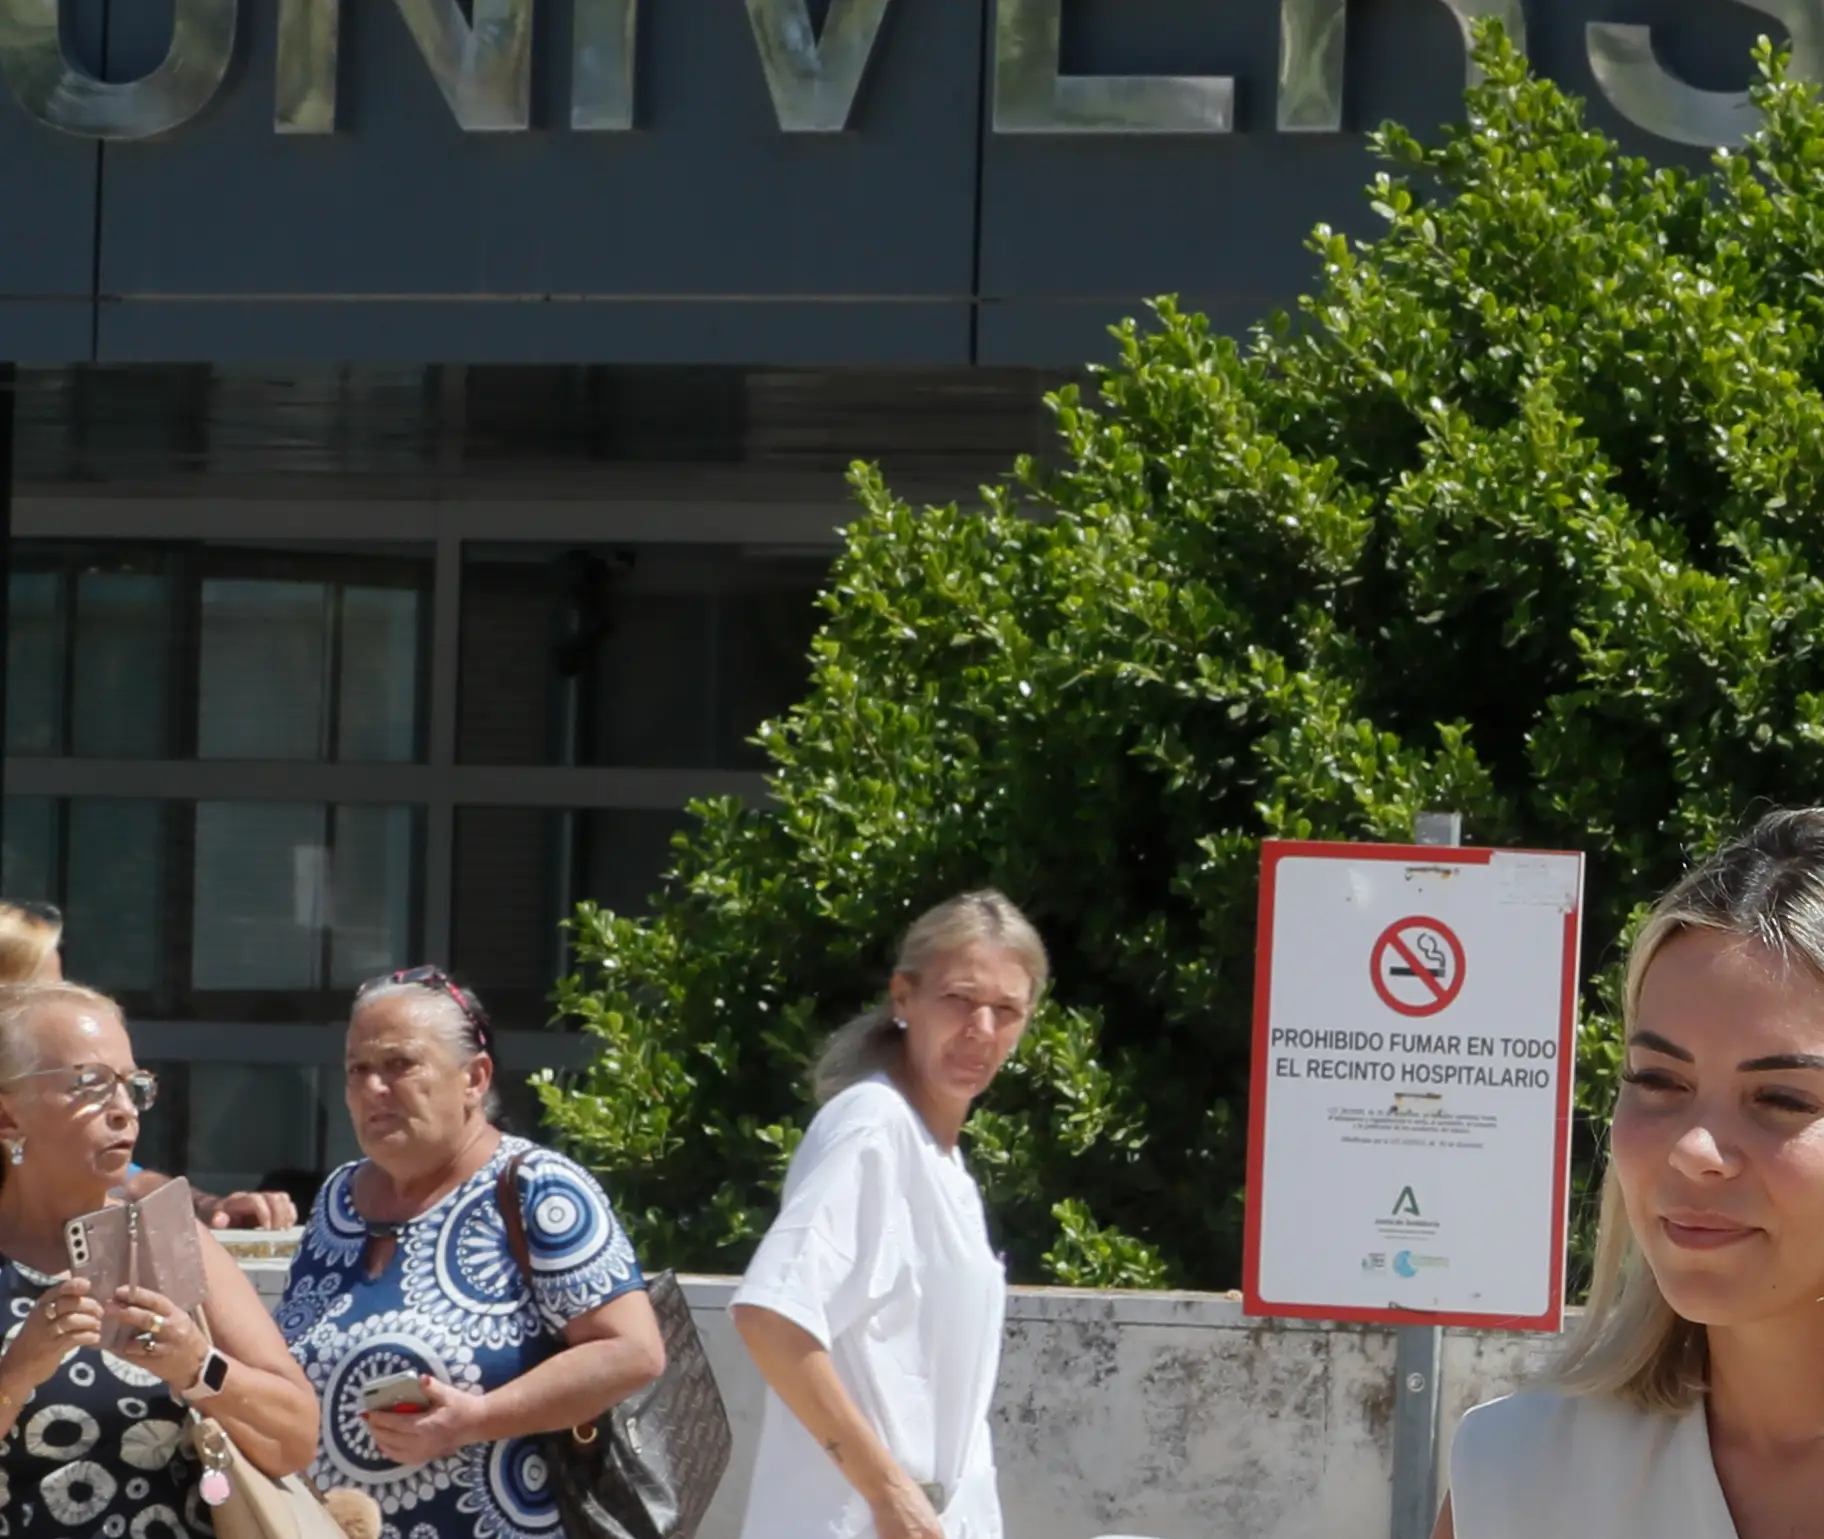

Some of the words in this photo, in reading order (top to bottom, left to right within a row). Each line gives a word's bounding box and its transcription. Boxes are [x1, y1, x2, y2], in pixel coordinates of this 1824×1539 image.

[1271, 1028, 1384, 1052] PROHIBIDO
[1389, 1032, 1460, 1055] FUMAR
[1467, 1036, 1494, 1057] EN
[1500, 1037, 1557, 1060] TODO
[1275, 1057, 1301, 1078] EL
[1306, 1058, 1396, 1082] RECINTO
[1400, 1063, 1550, 1089] HOSPITALARIO
